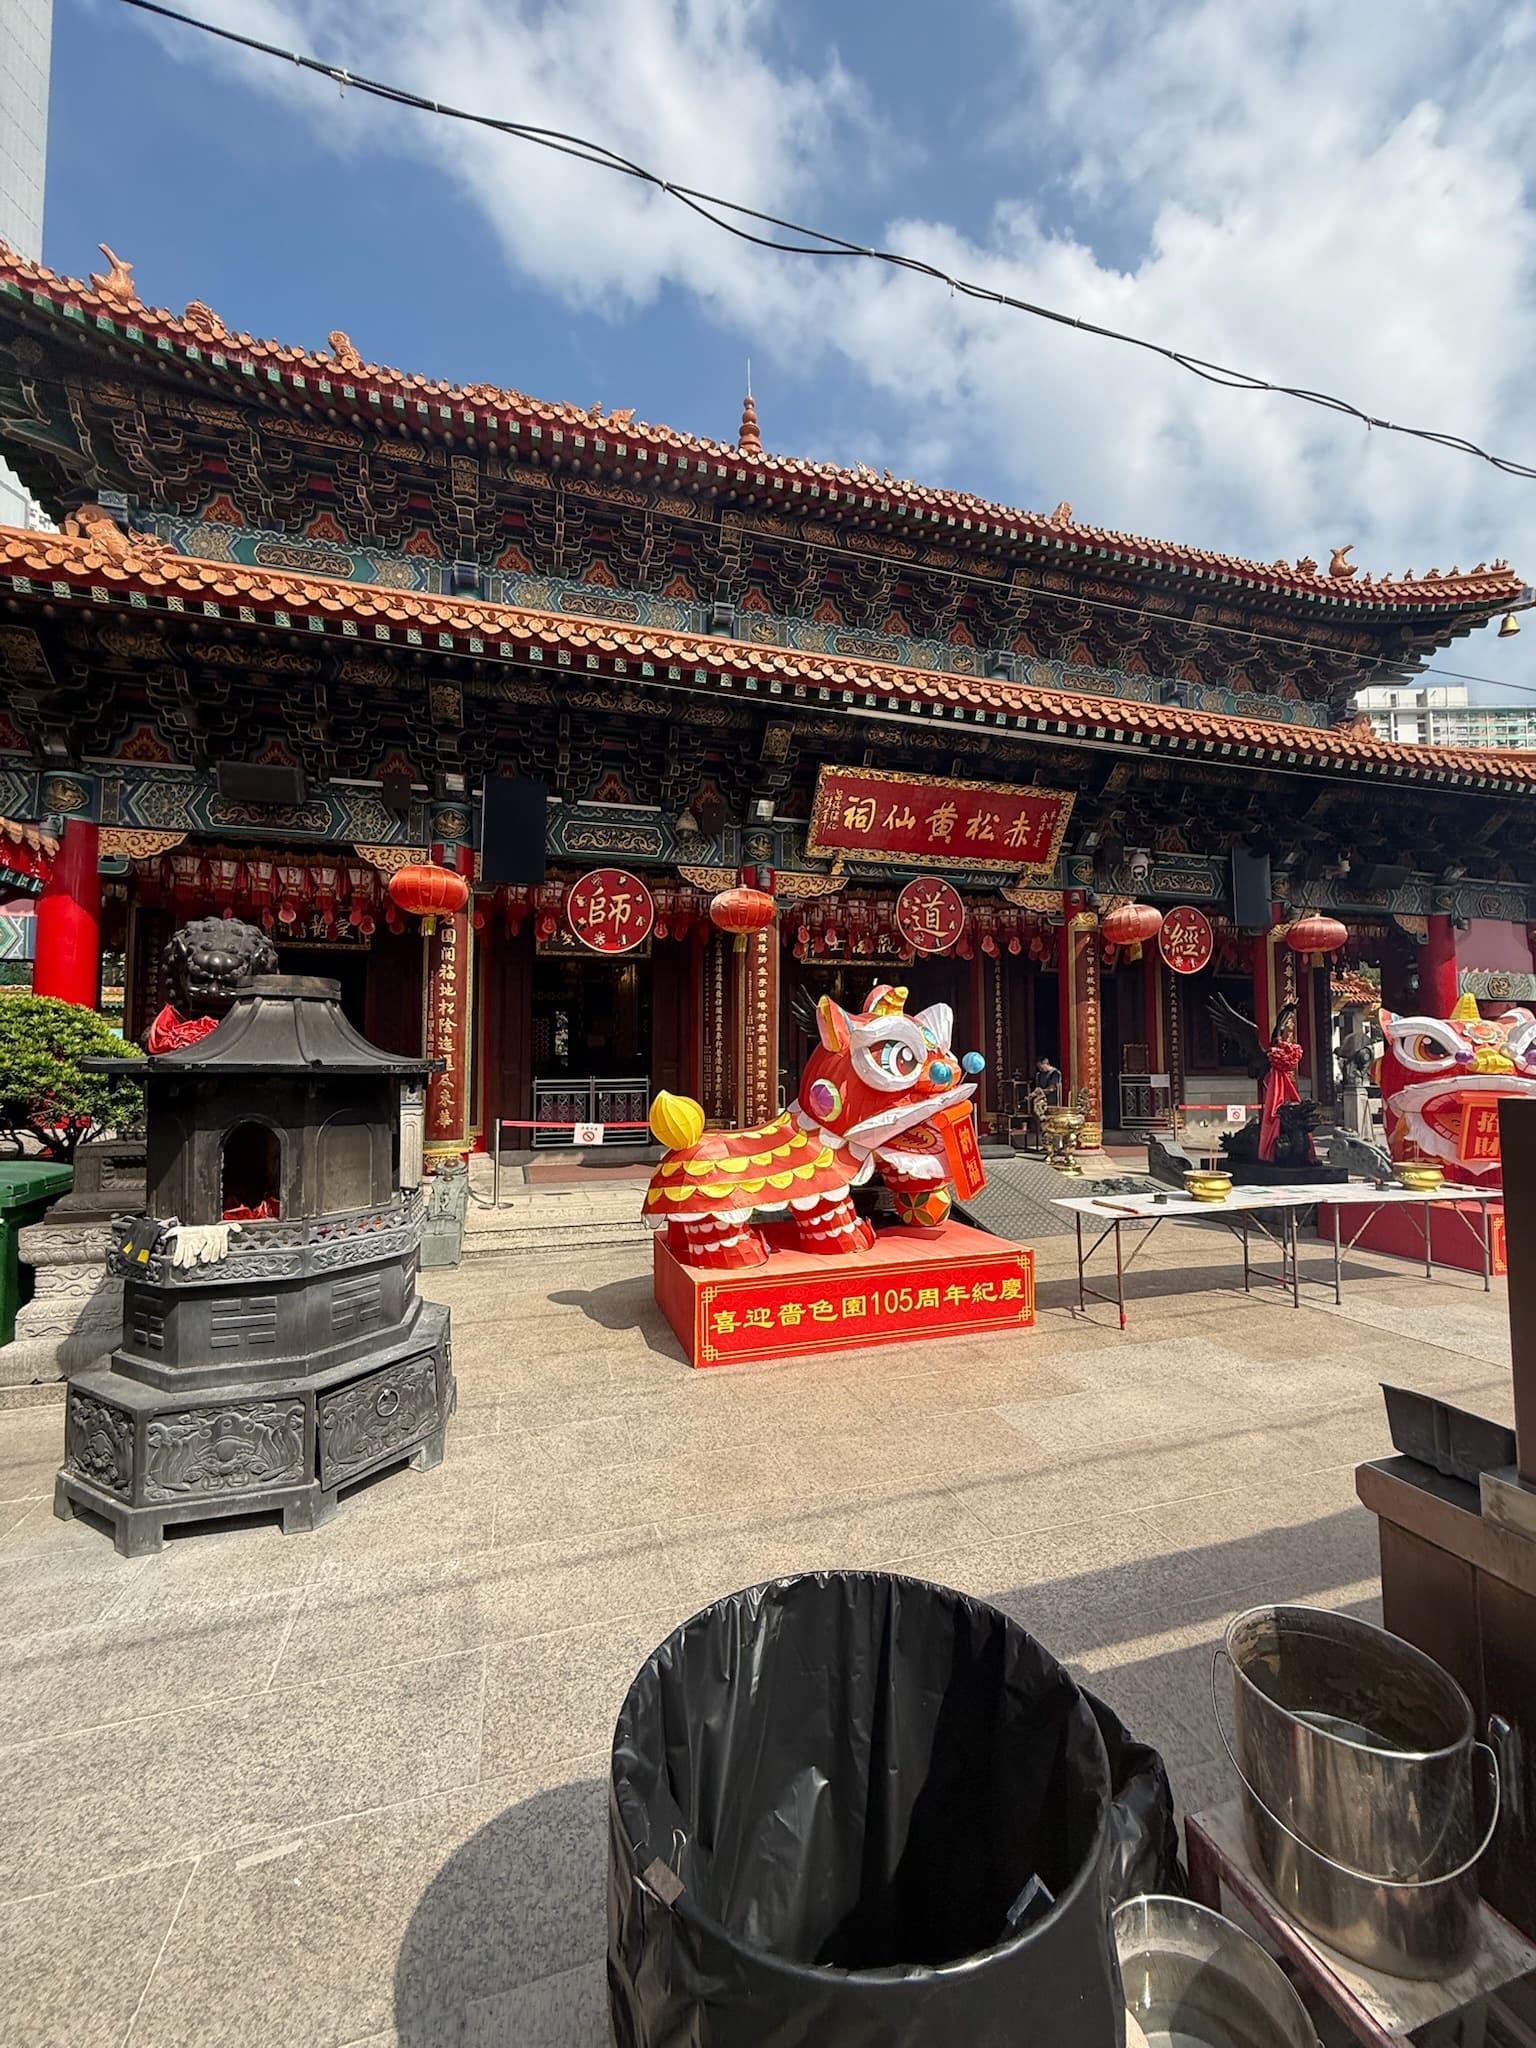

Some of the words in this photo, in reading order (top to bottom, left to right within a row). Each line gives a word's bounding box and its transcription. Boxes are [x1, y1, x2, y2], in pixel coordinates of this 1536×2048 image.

[588, 886, 631, 934] 師
[911, 891, 949, 937] 道
[1170, 921, 1199, 956] 經
